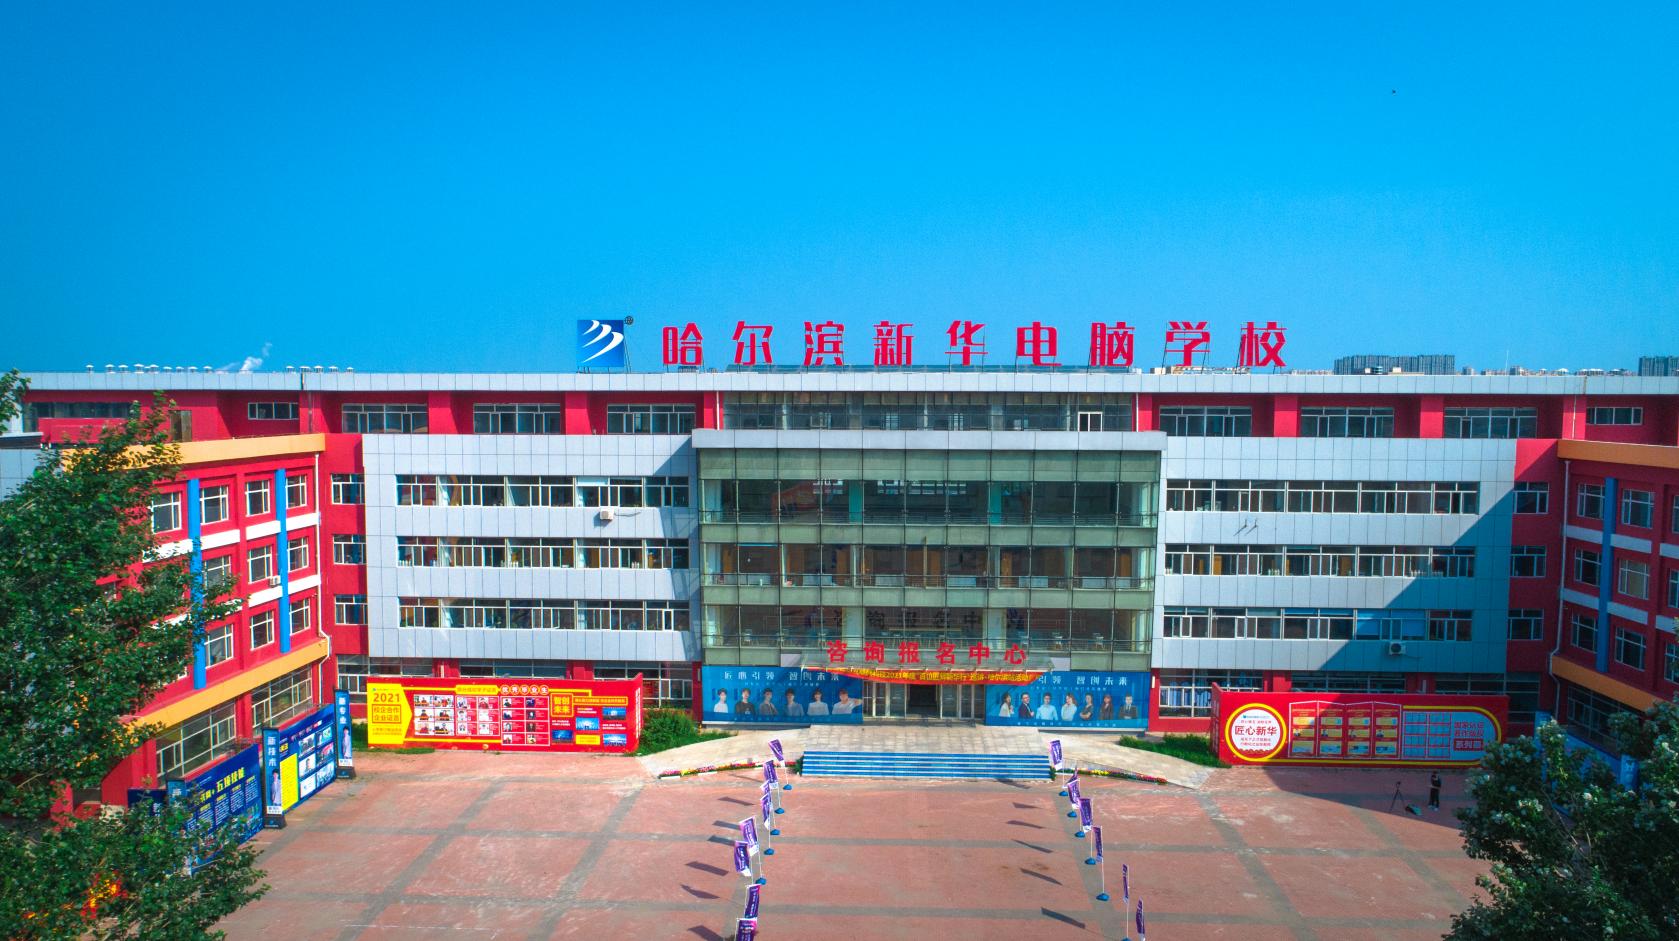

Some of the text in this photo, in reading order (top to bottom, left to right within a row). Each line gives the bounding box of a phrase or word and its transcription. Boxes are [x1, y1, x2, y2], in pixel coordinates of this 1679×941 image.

[662, 320, 1286, 367] 哈尔滨新华电脑学校
[826, 640, 1028, 665] 咨询报名中心
[1076, 676, 1128, 686] 智创未来
[373, 693, 400, 702] 2021
[1235, 726, 1277, 736] 匠心新华
